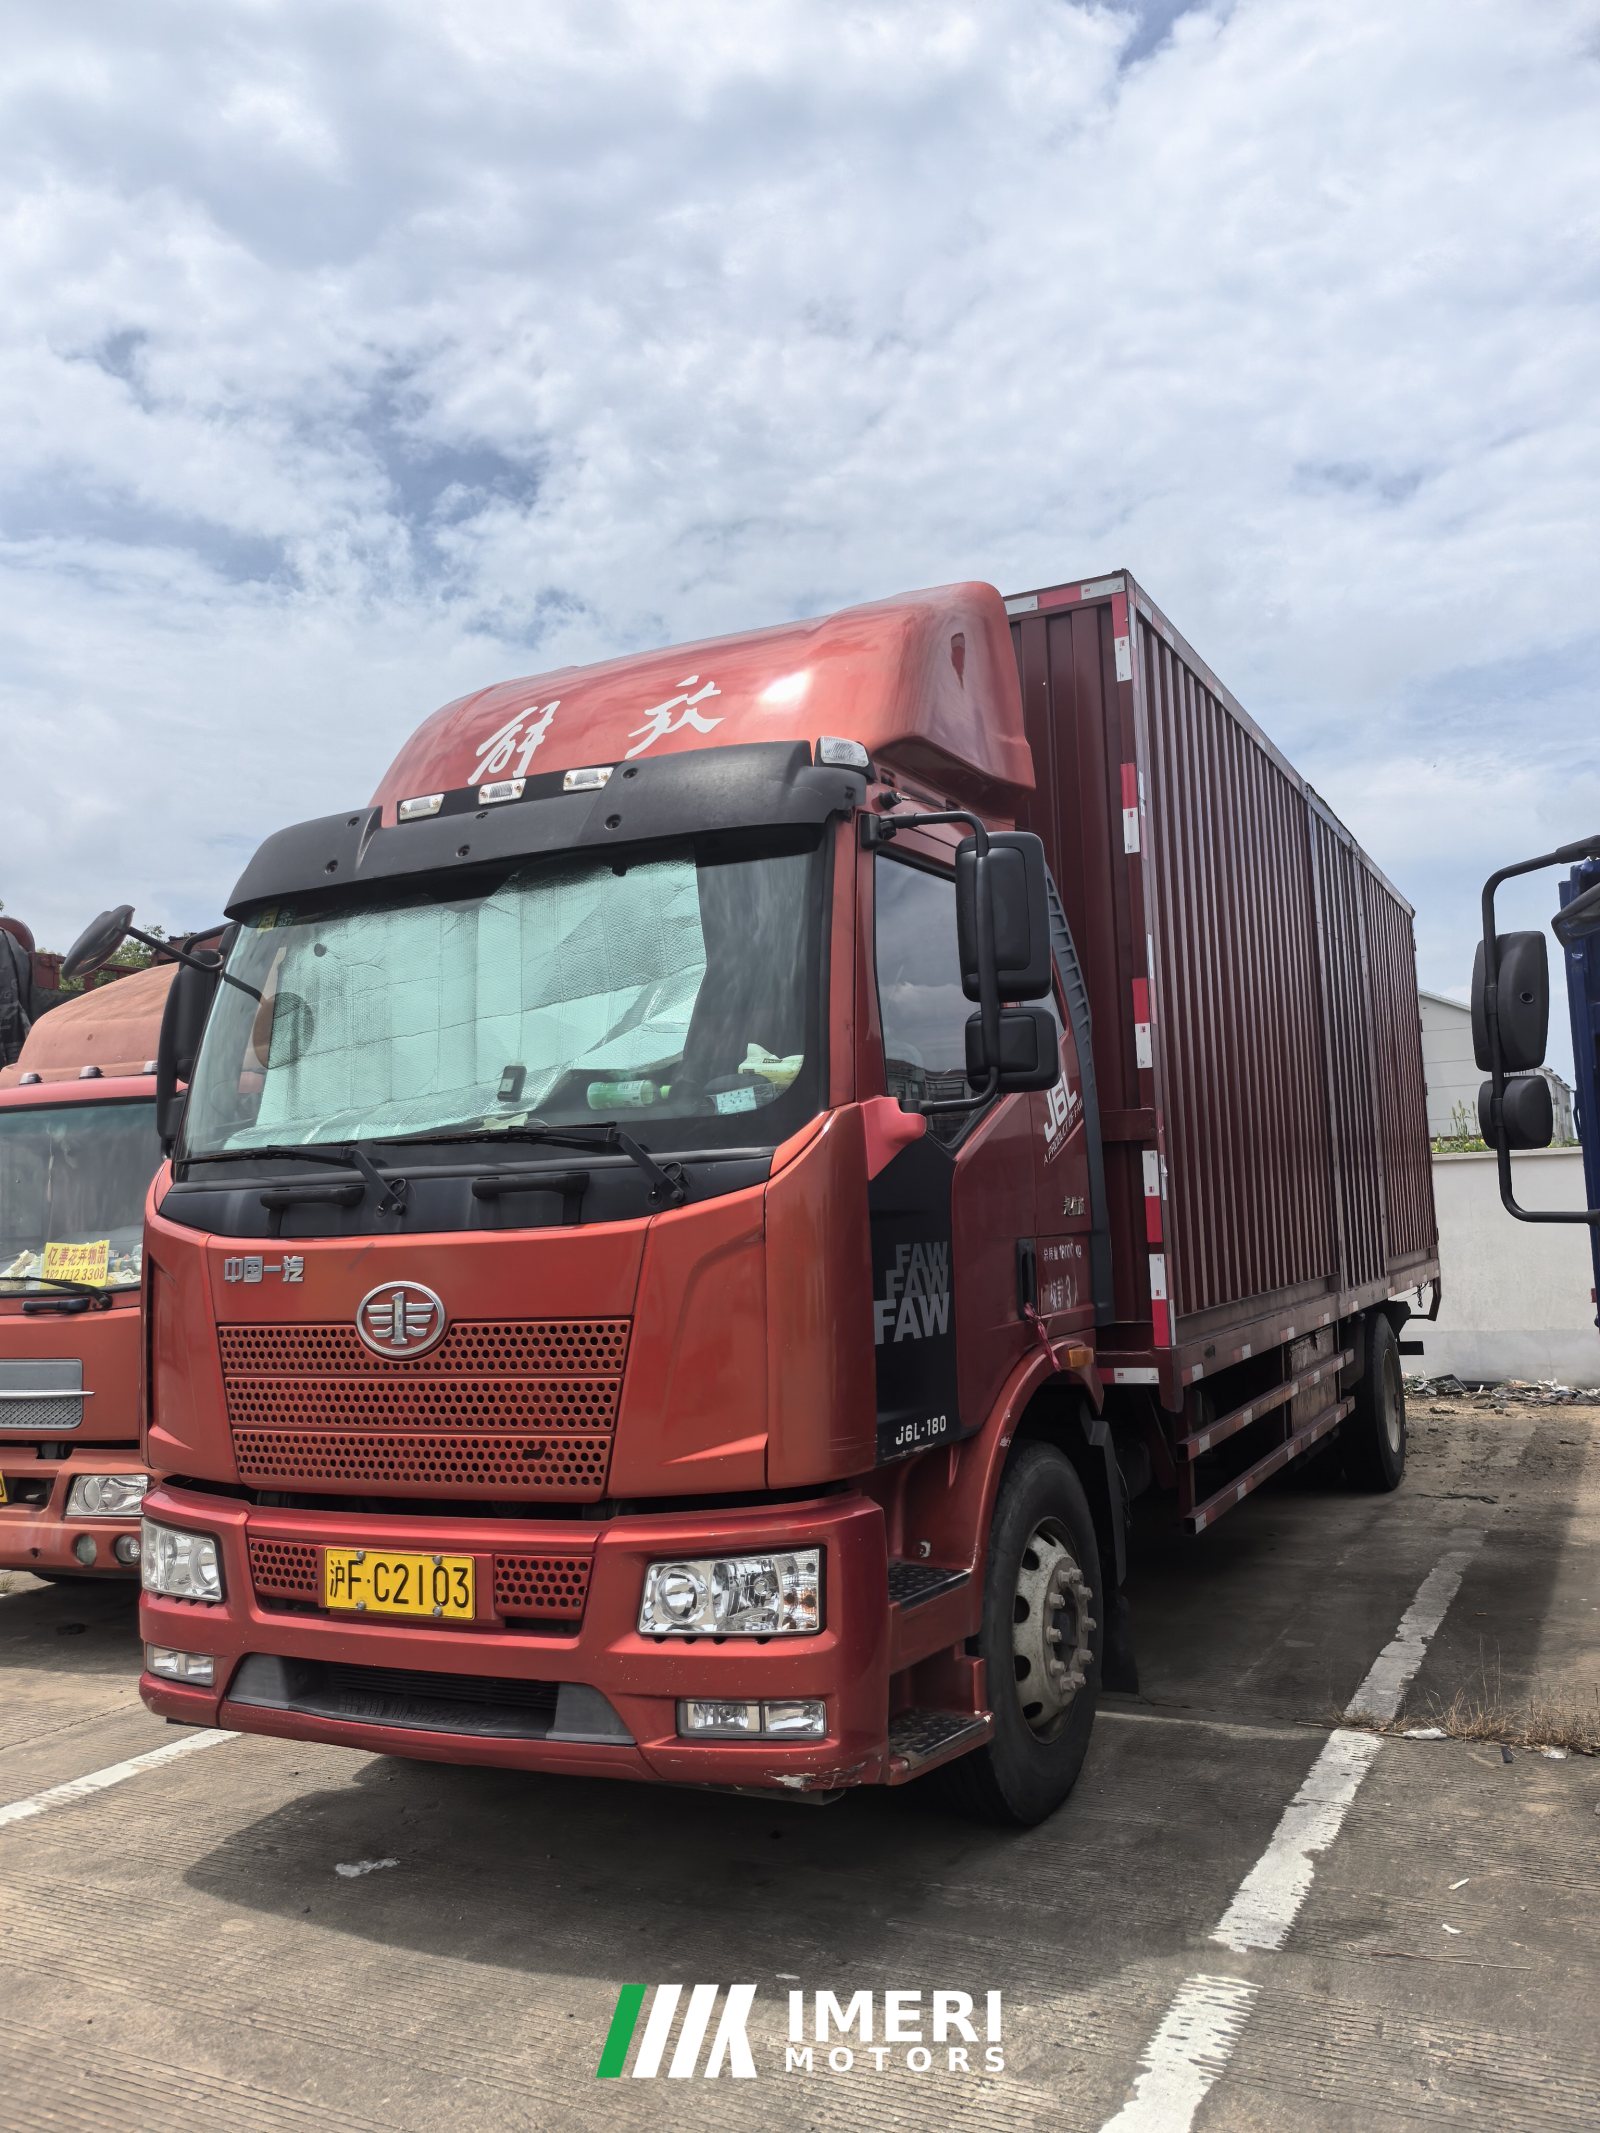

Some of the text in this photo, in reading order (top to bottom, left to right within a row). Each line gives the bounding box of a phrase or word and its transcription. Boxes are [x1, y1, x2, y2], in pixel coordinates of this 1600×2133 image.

[1043, 1071, 1078, 1143] J6L
[224, 1255, 304, 1283] 中国一汽
[896, 1241, 948, 1275] FAW
[886, 1264, 948, 1303] FAW
[873, 1292, 950, 1345] FAW
